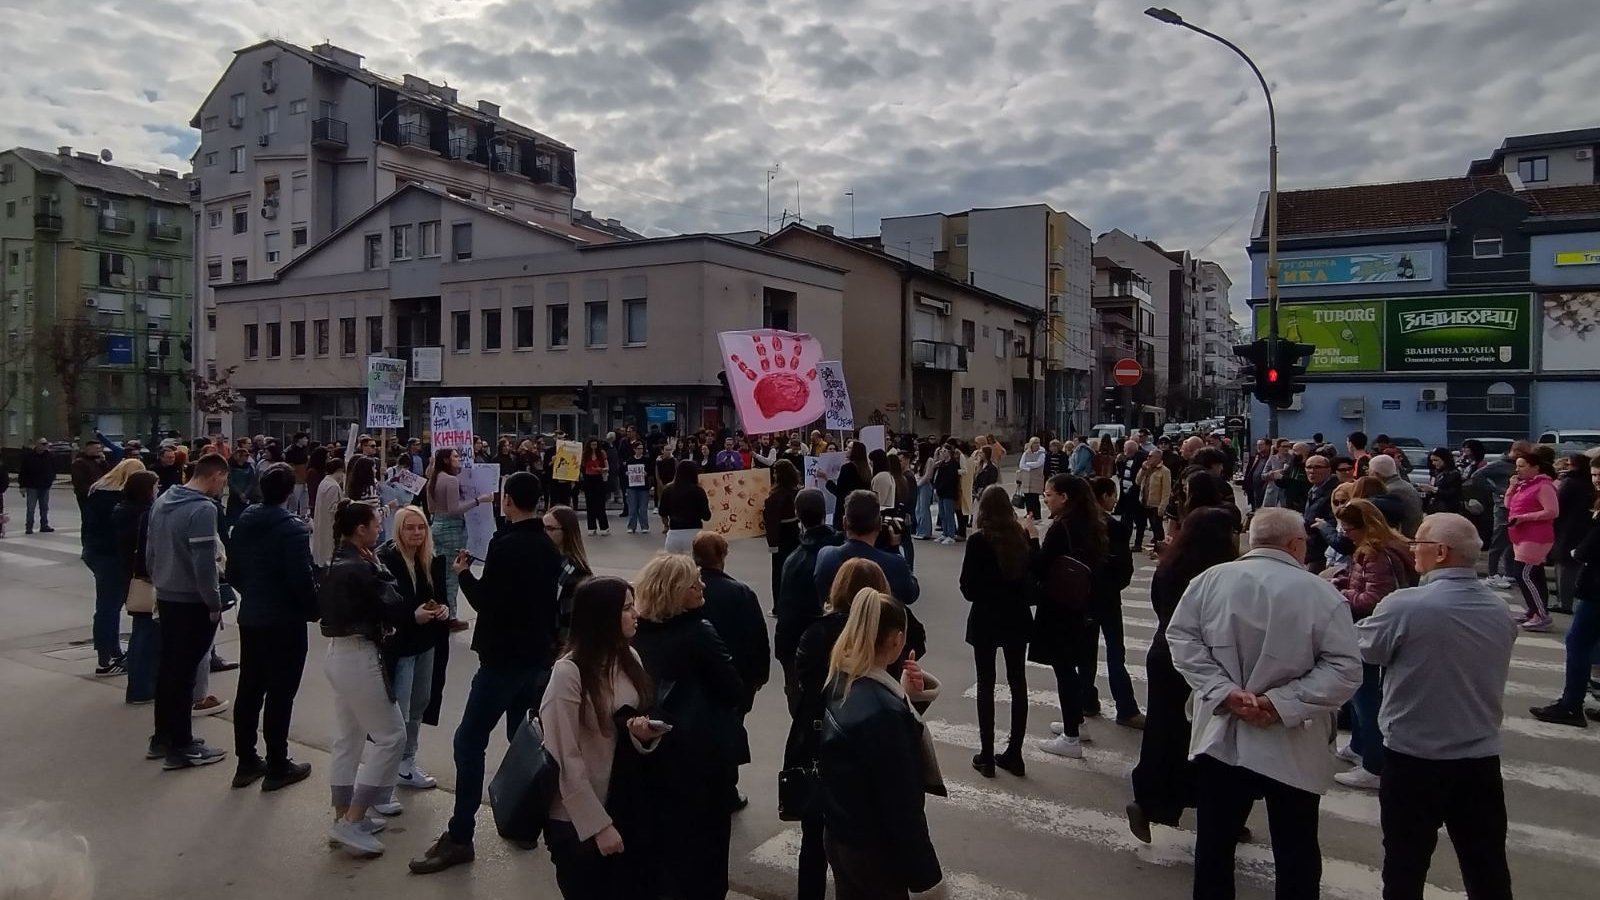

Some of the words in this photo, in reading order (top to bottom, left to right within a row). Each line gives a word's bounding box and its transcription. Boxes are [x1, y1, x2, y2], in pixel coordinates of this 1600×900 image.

[1313, 308, 1376, 323] TUBORG
[1314, 348, 1341, 356] OPEN
[1404, 347, 1459, 355] ЗВАНИЧНА
[1461, 346, 1496, 354] ХРАНА
[1314, 356, 1328, 364] TO
[1330, 355, 1360, 363] MORE
[433, 430, 472, 447] КИЧМА
